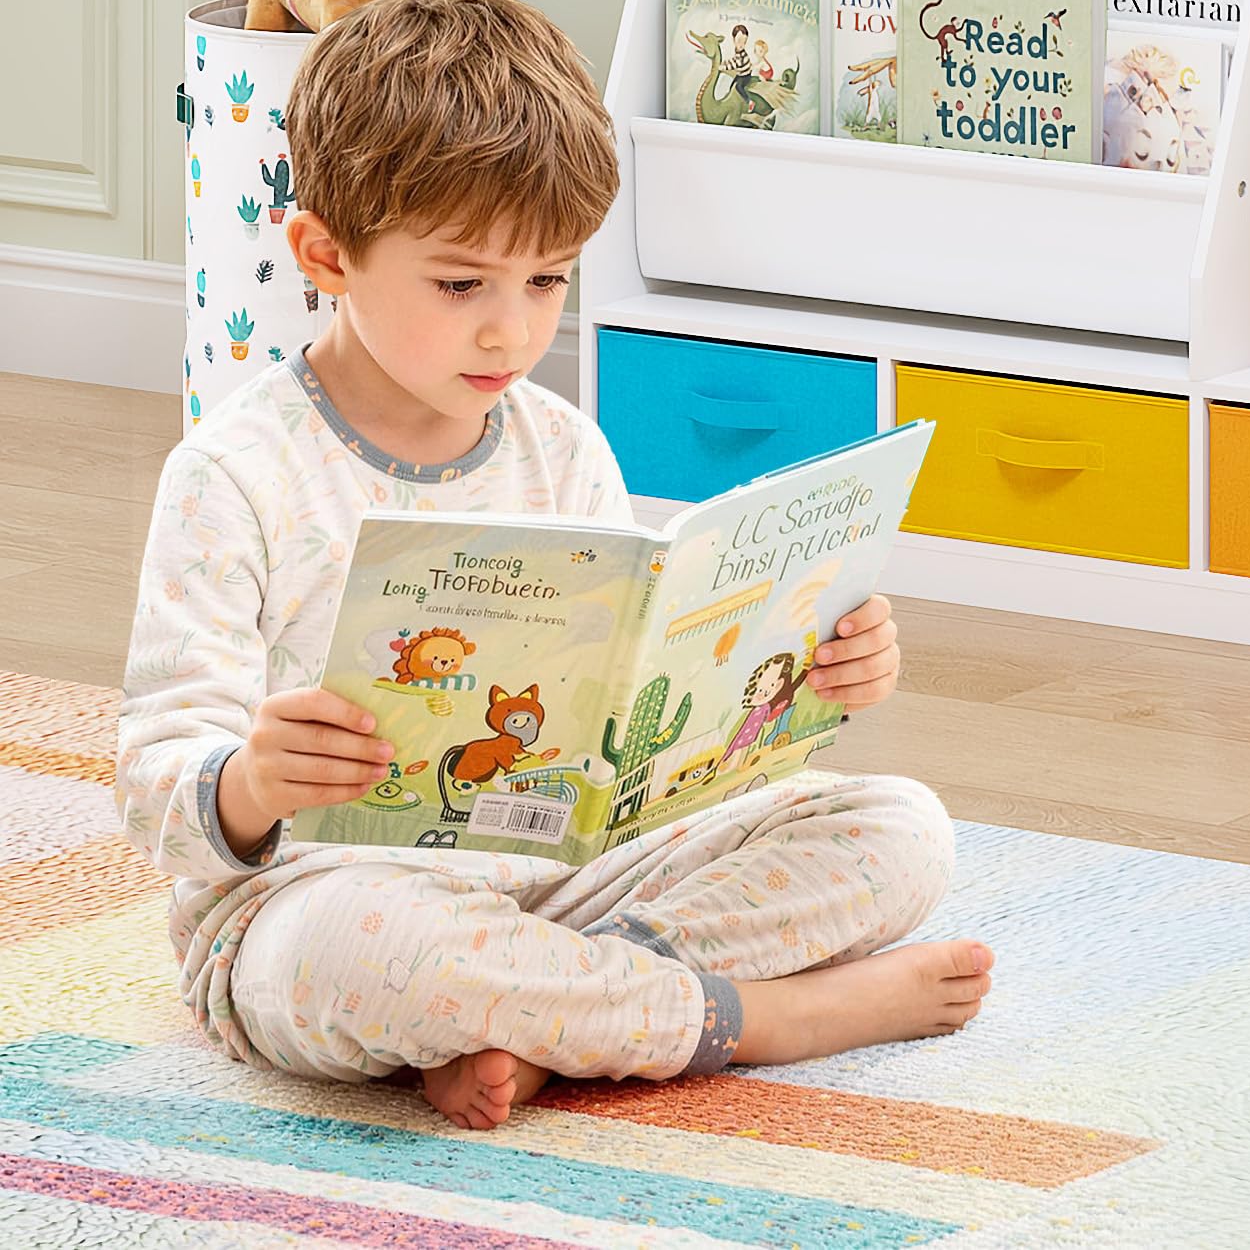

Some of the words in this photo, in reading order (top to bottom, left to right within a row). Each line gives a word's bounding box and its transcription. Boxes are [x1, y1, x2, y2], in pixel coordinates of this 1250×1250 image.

[964, 18, 1048, 60] Read
[941, 53, 976, 88] to
[990, 65, 1067, 101] your
[936, 100, 1076, 150] toddler
